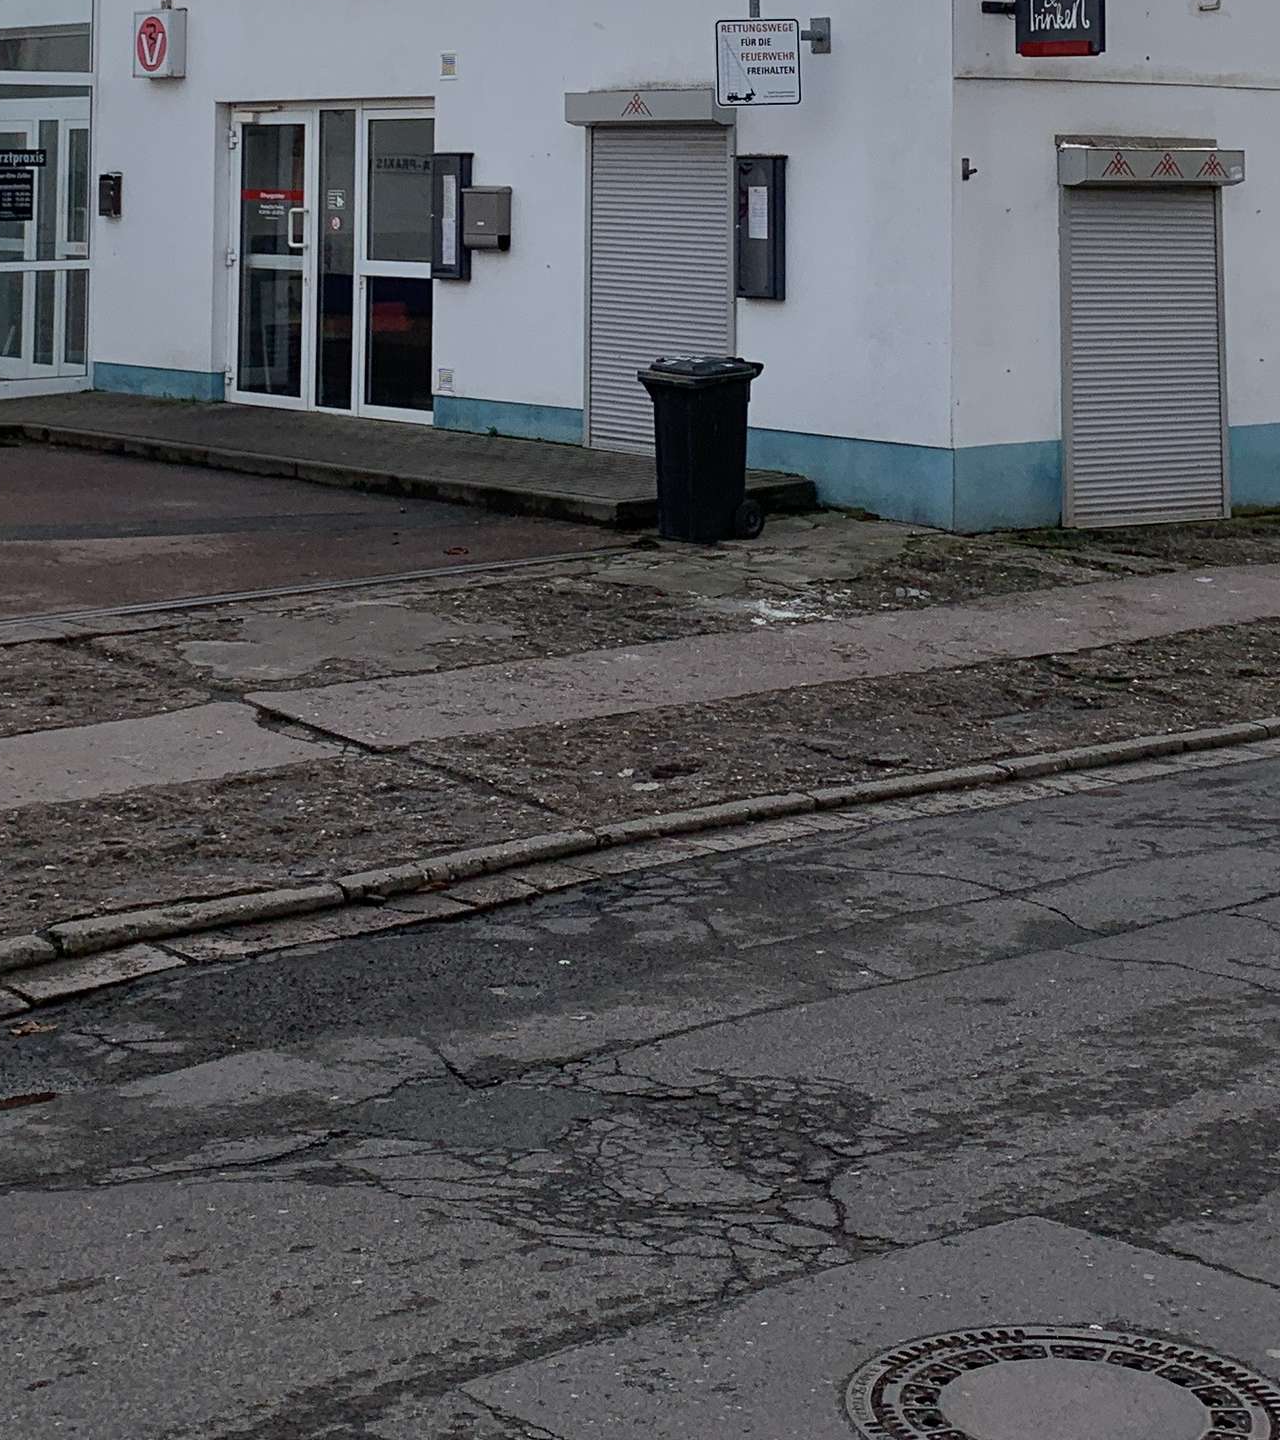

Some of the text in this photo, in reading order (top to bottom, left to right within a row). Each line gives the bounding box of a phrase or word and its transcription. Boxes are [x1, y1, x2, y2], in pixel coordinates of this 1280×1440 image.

[721, 23, 794, 33] RETTUNGSWEGE
[741, 37, 772, 47] FÜR DIE
[741, 52, 795, 62] FEUERWEHR
[747, 66, 795, 75] FREIHALTEN
